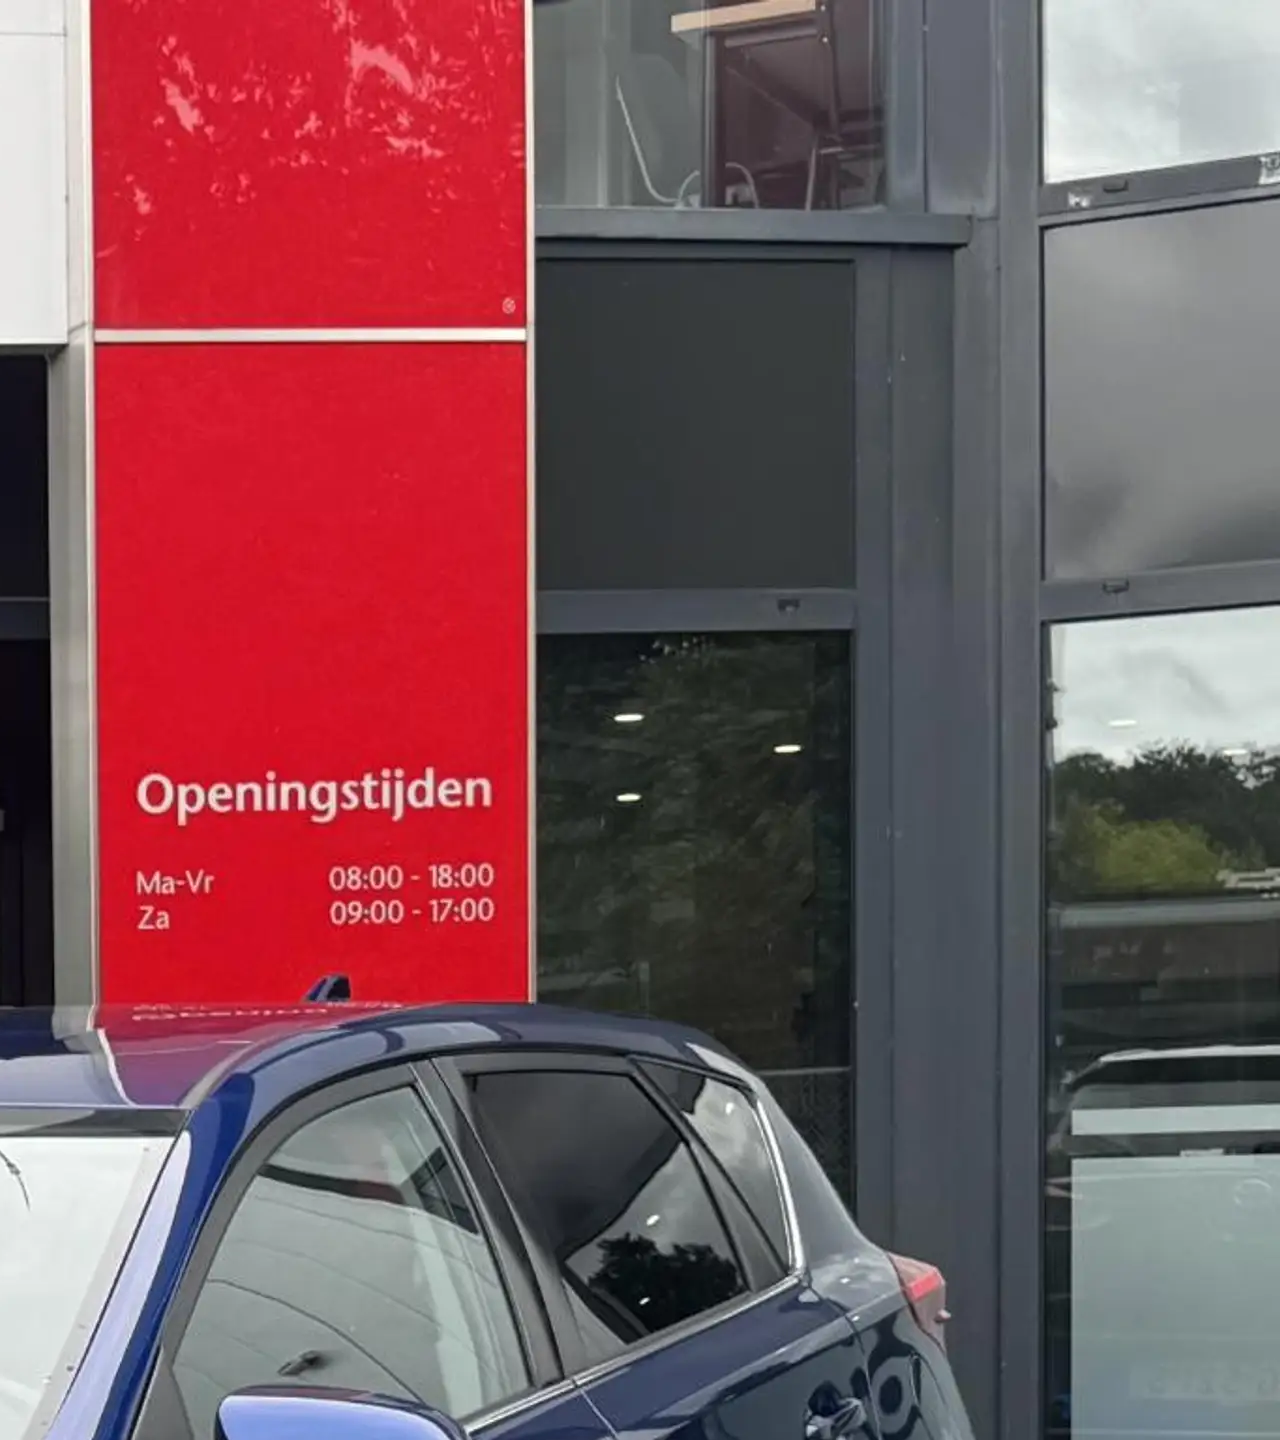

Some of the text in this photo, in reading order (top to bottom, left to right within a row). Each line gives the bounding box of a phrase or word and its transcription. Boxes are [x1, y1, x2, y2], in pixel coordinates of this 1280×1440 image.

[136, 768, 493, 826] Openingstijden
[136, 869, 215, 895] Ma-Vr
[329, 865, 403, 891] 08:00
[428, 863, 495, 889] 18:00
[137, 906, 170, 930] Za
[329, 900, 404, 926] 09:00
[429, 897, 495, 923] 17:00
